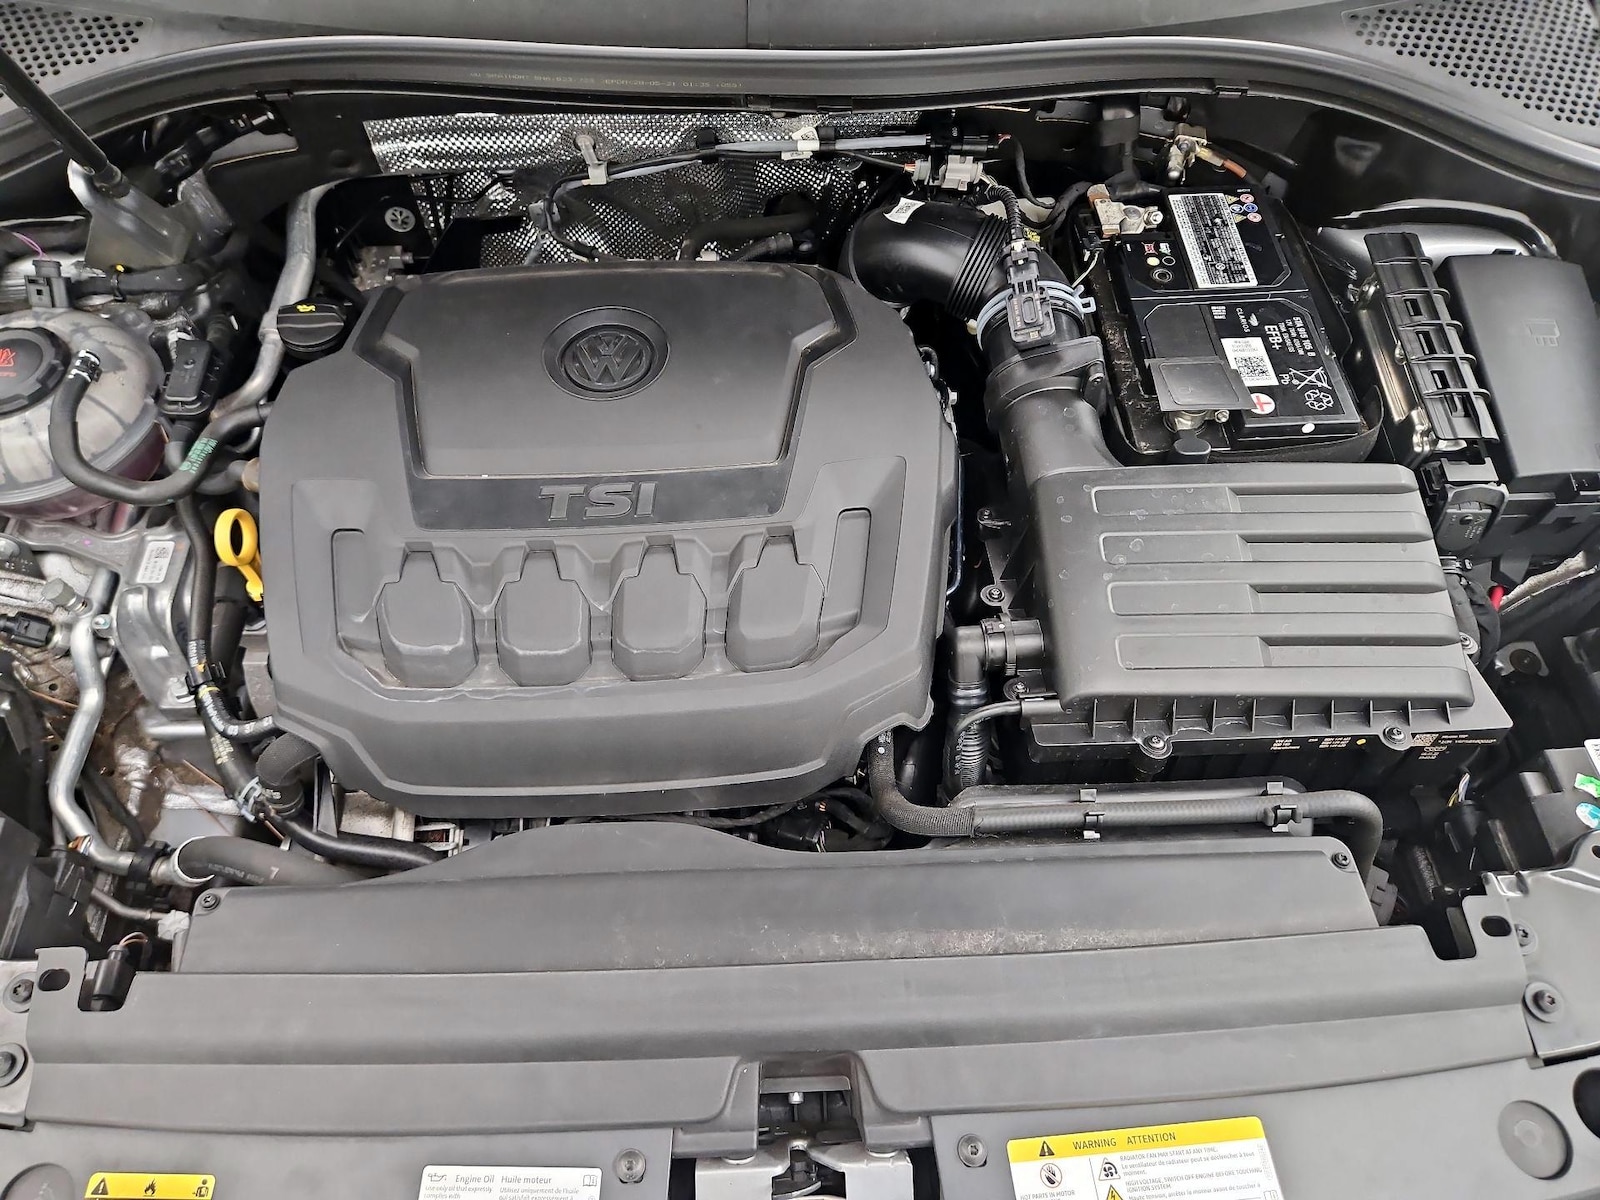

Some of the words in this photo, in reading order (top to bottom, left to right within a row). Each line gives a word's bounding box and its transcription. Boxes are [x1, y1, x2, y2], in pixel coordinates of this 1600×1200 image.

[1236, 308, 1250, 332] CLARIOS
[1264, 325, 1283, 350] EFB+
[1279, 374, 1290, 384] Pb
[538, 481, 658, 521] TSI
[1073, 1138, 1116, 1150] WARNING
[1127, 1132, 1176, 1145] ATTENTION
[456, 1174, 481, 1184] Engine
[484, 1174, 494, 1183] Oil
